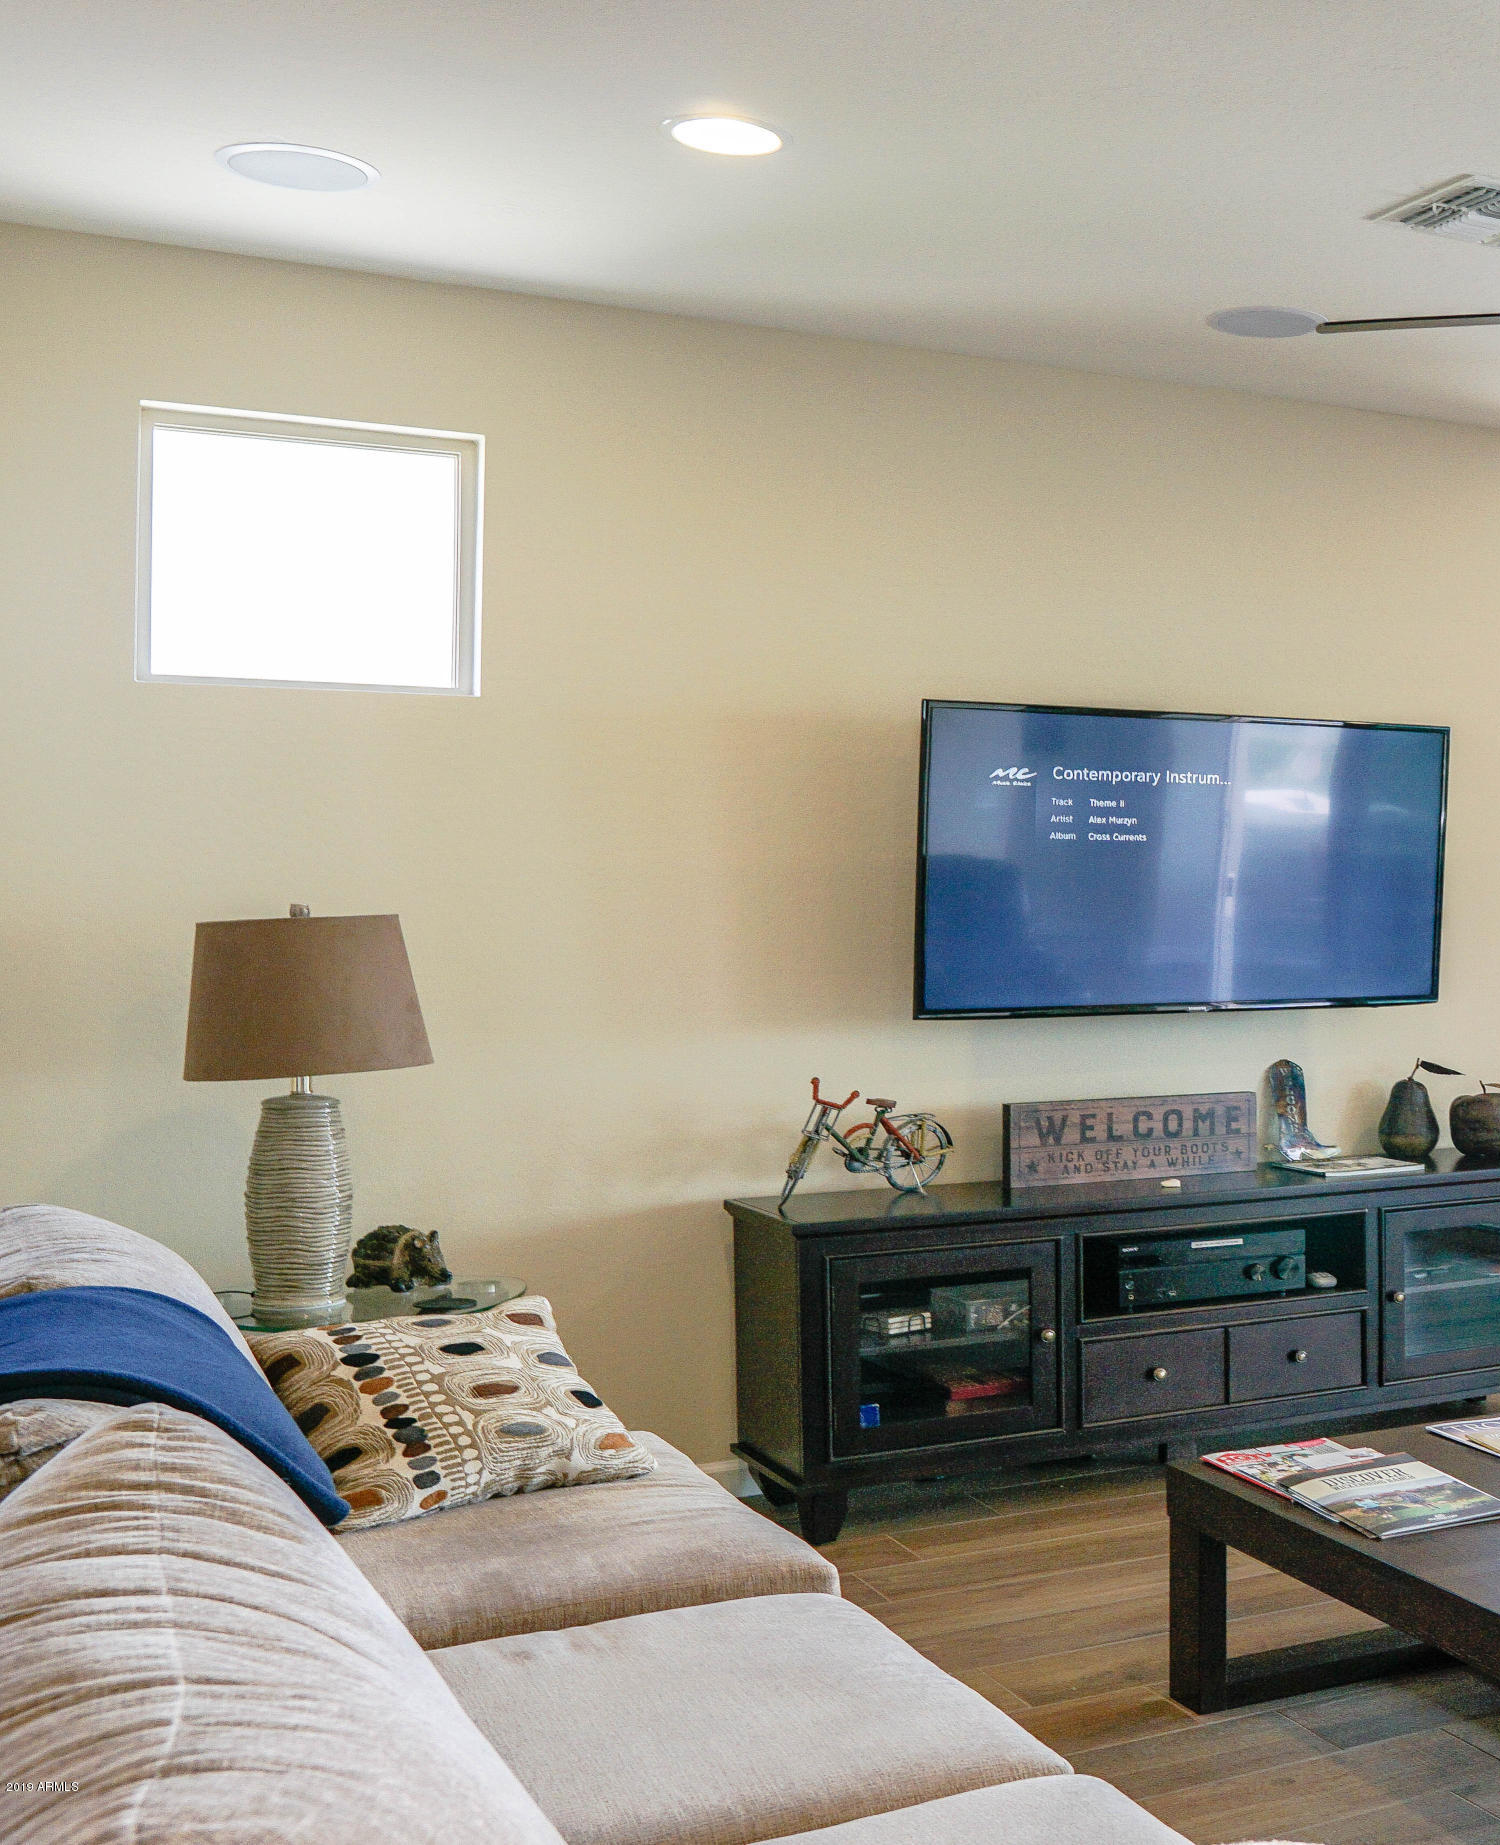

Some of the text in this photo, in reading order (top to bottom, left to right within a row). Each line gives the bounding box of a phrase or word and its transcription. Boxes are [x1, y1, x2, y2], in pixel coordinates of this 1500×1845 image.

[1053, 766, 1161, 786] Contemporary
[1051, 798, 1073, 806] Track
[1089, 799, 1116, 808] Theme
[1050, 815, 1073, 823] Artist
[1088, 816, 1106, 824] Alex
[1049, 832, 1147, 842] Album Cross Currents
[1034, 1105, 1241, 1146] WELCOME
[1047, 1141, 1229, 1164] KICK OFF YOUR BOOTS
[1061, 1155, 1215, 1176] AND STAY A WHILE
[1321, 1467, 1410, 1487] DISCOVER
